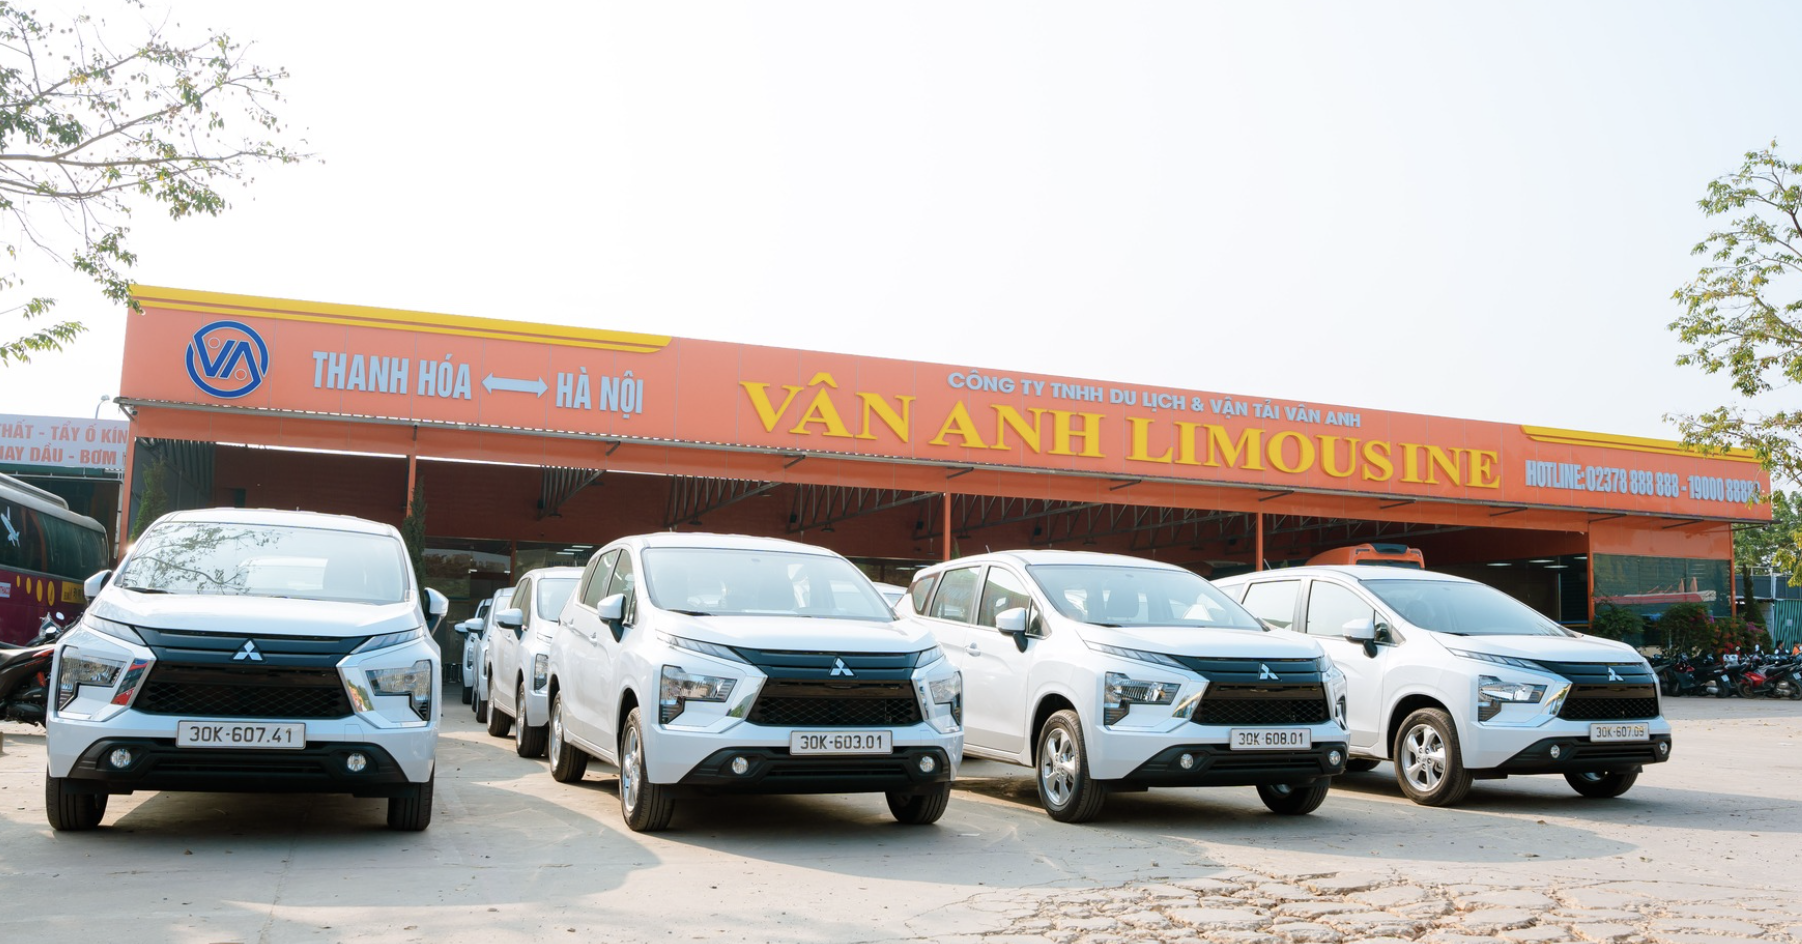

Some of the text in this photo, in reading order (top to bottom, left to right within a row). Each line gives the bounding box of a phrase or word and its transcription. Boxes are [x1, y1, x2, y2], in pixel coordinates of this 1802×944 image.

[312, 350, 644, 419] THANH HÓA HÀ NỘI
[947, 369, 1361, 428] CÔNG TY TNHH DU LỊCH & VẬN TẢI VÂN ANH
[0, 419, 34, 440] HẤT
[51, 420, 80, 442] TẨY
[85, 423, 97, 443] Ố
[739, 372, 1501, 490] VÂN ANH LIMOUSINE
[29, 442, 64, 463] DẦU
[80, 449, 117, 466] BƠM
[1629, 469, 1654, 495] 888
[1655, 471, 1680, 498] 888
[1687, 474, 1725, 502] 19000
[189, 725, 293, 744] 30K-607.41
[800, 734, 883, 750] 30K-603.01
